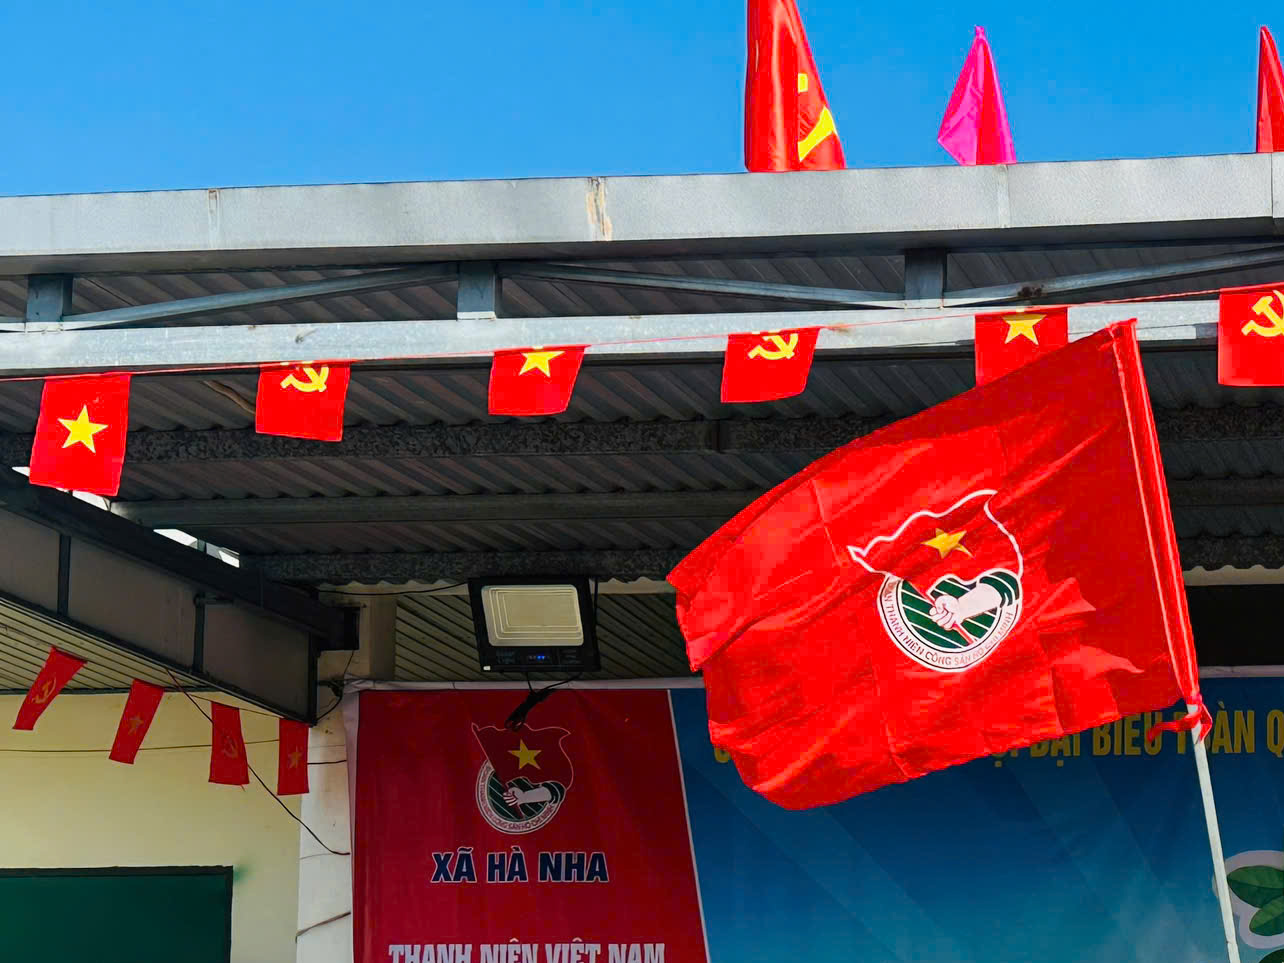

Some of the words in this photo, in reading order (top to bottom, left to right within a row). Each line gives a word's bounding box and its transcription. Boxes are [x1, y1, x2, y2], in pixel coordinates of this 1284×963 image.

[1174, 700, 1256, 755] TÀN
[431, 847, 477, 883] XÃ
[487, 846, 528, 883] HÀ
[538, 852, 609, 883] NHA
